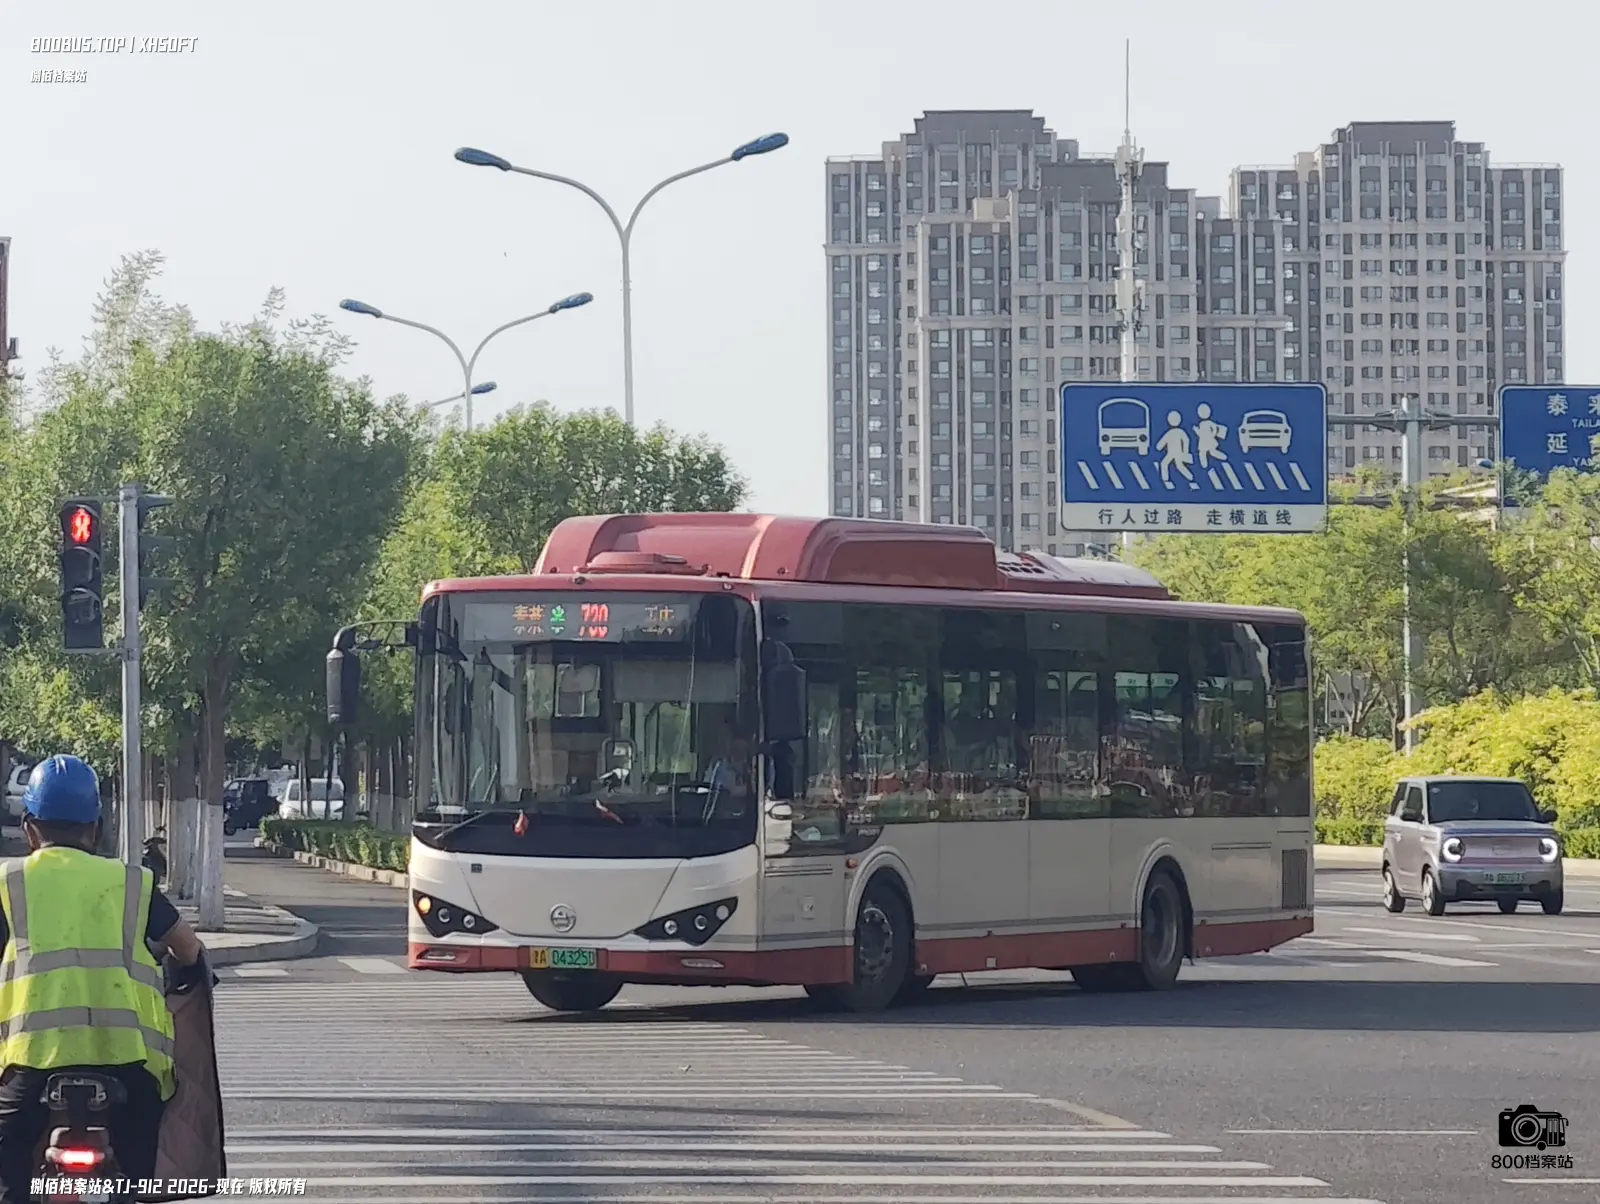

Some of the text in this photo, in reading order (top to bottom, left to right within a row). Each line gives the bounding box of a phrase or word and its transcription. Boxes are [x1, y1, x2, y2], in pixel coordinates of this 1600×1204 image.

[1098, 508, 1292, 526] 行人过路 走横道线
